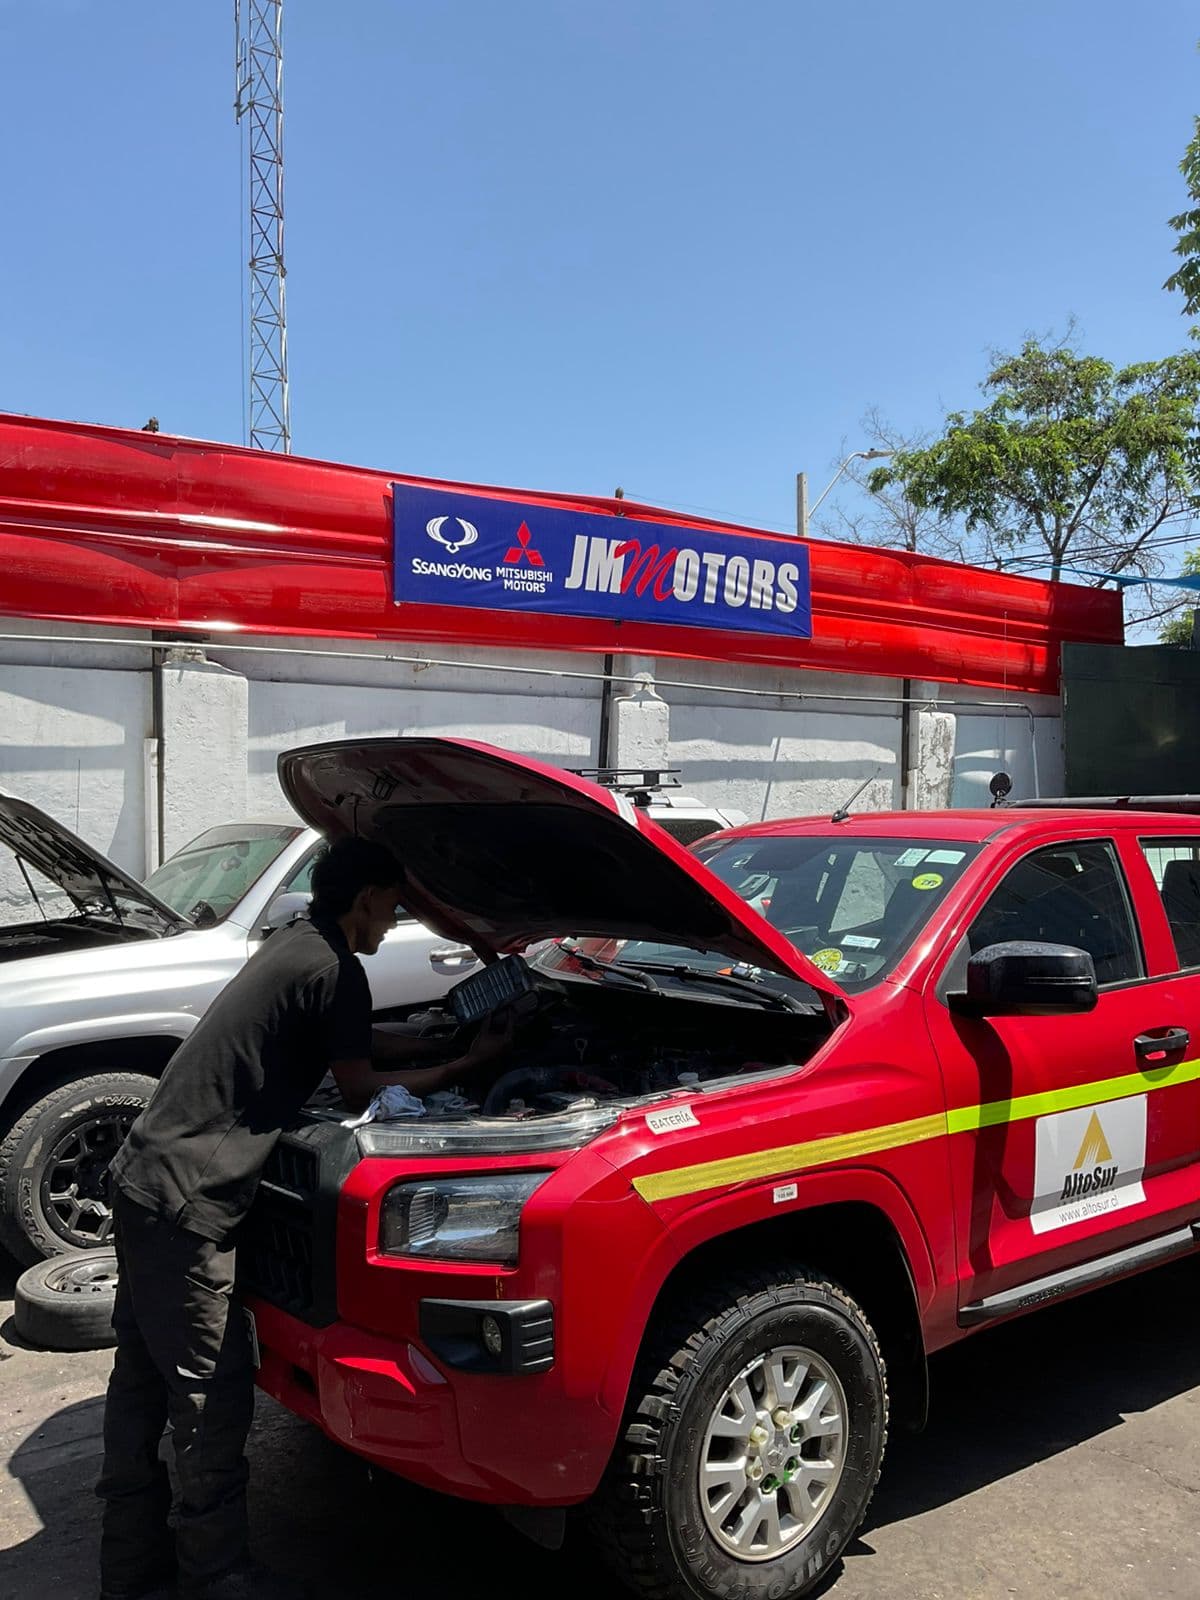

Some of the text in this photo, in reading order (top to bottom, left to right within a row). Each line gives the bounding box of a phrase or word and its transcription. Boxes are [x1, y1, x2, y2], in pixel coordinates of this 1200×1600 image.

[495, 566, 553, 583] MITSUBISHI
[503, 578, 546, 594] MOTORS
[650, 1110, 694, 1130] BATERÍA
[1060, 1165, 1118, 1201] AltoSur
[1059, 1194, 1119, 1223] www.altosur.cl
